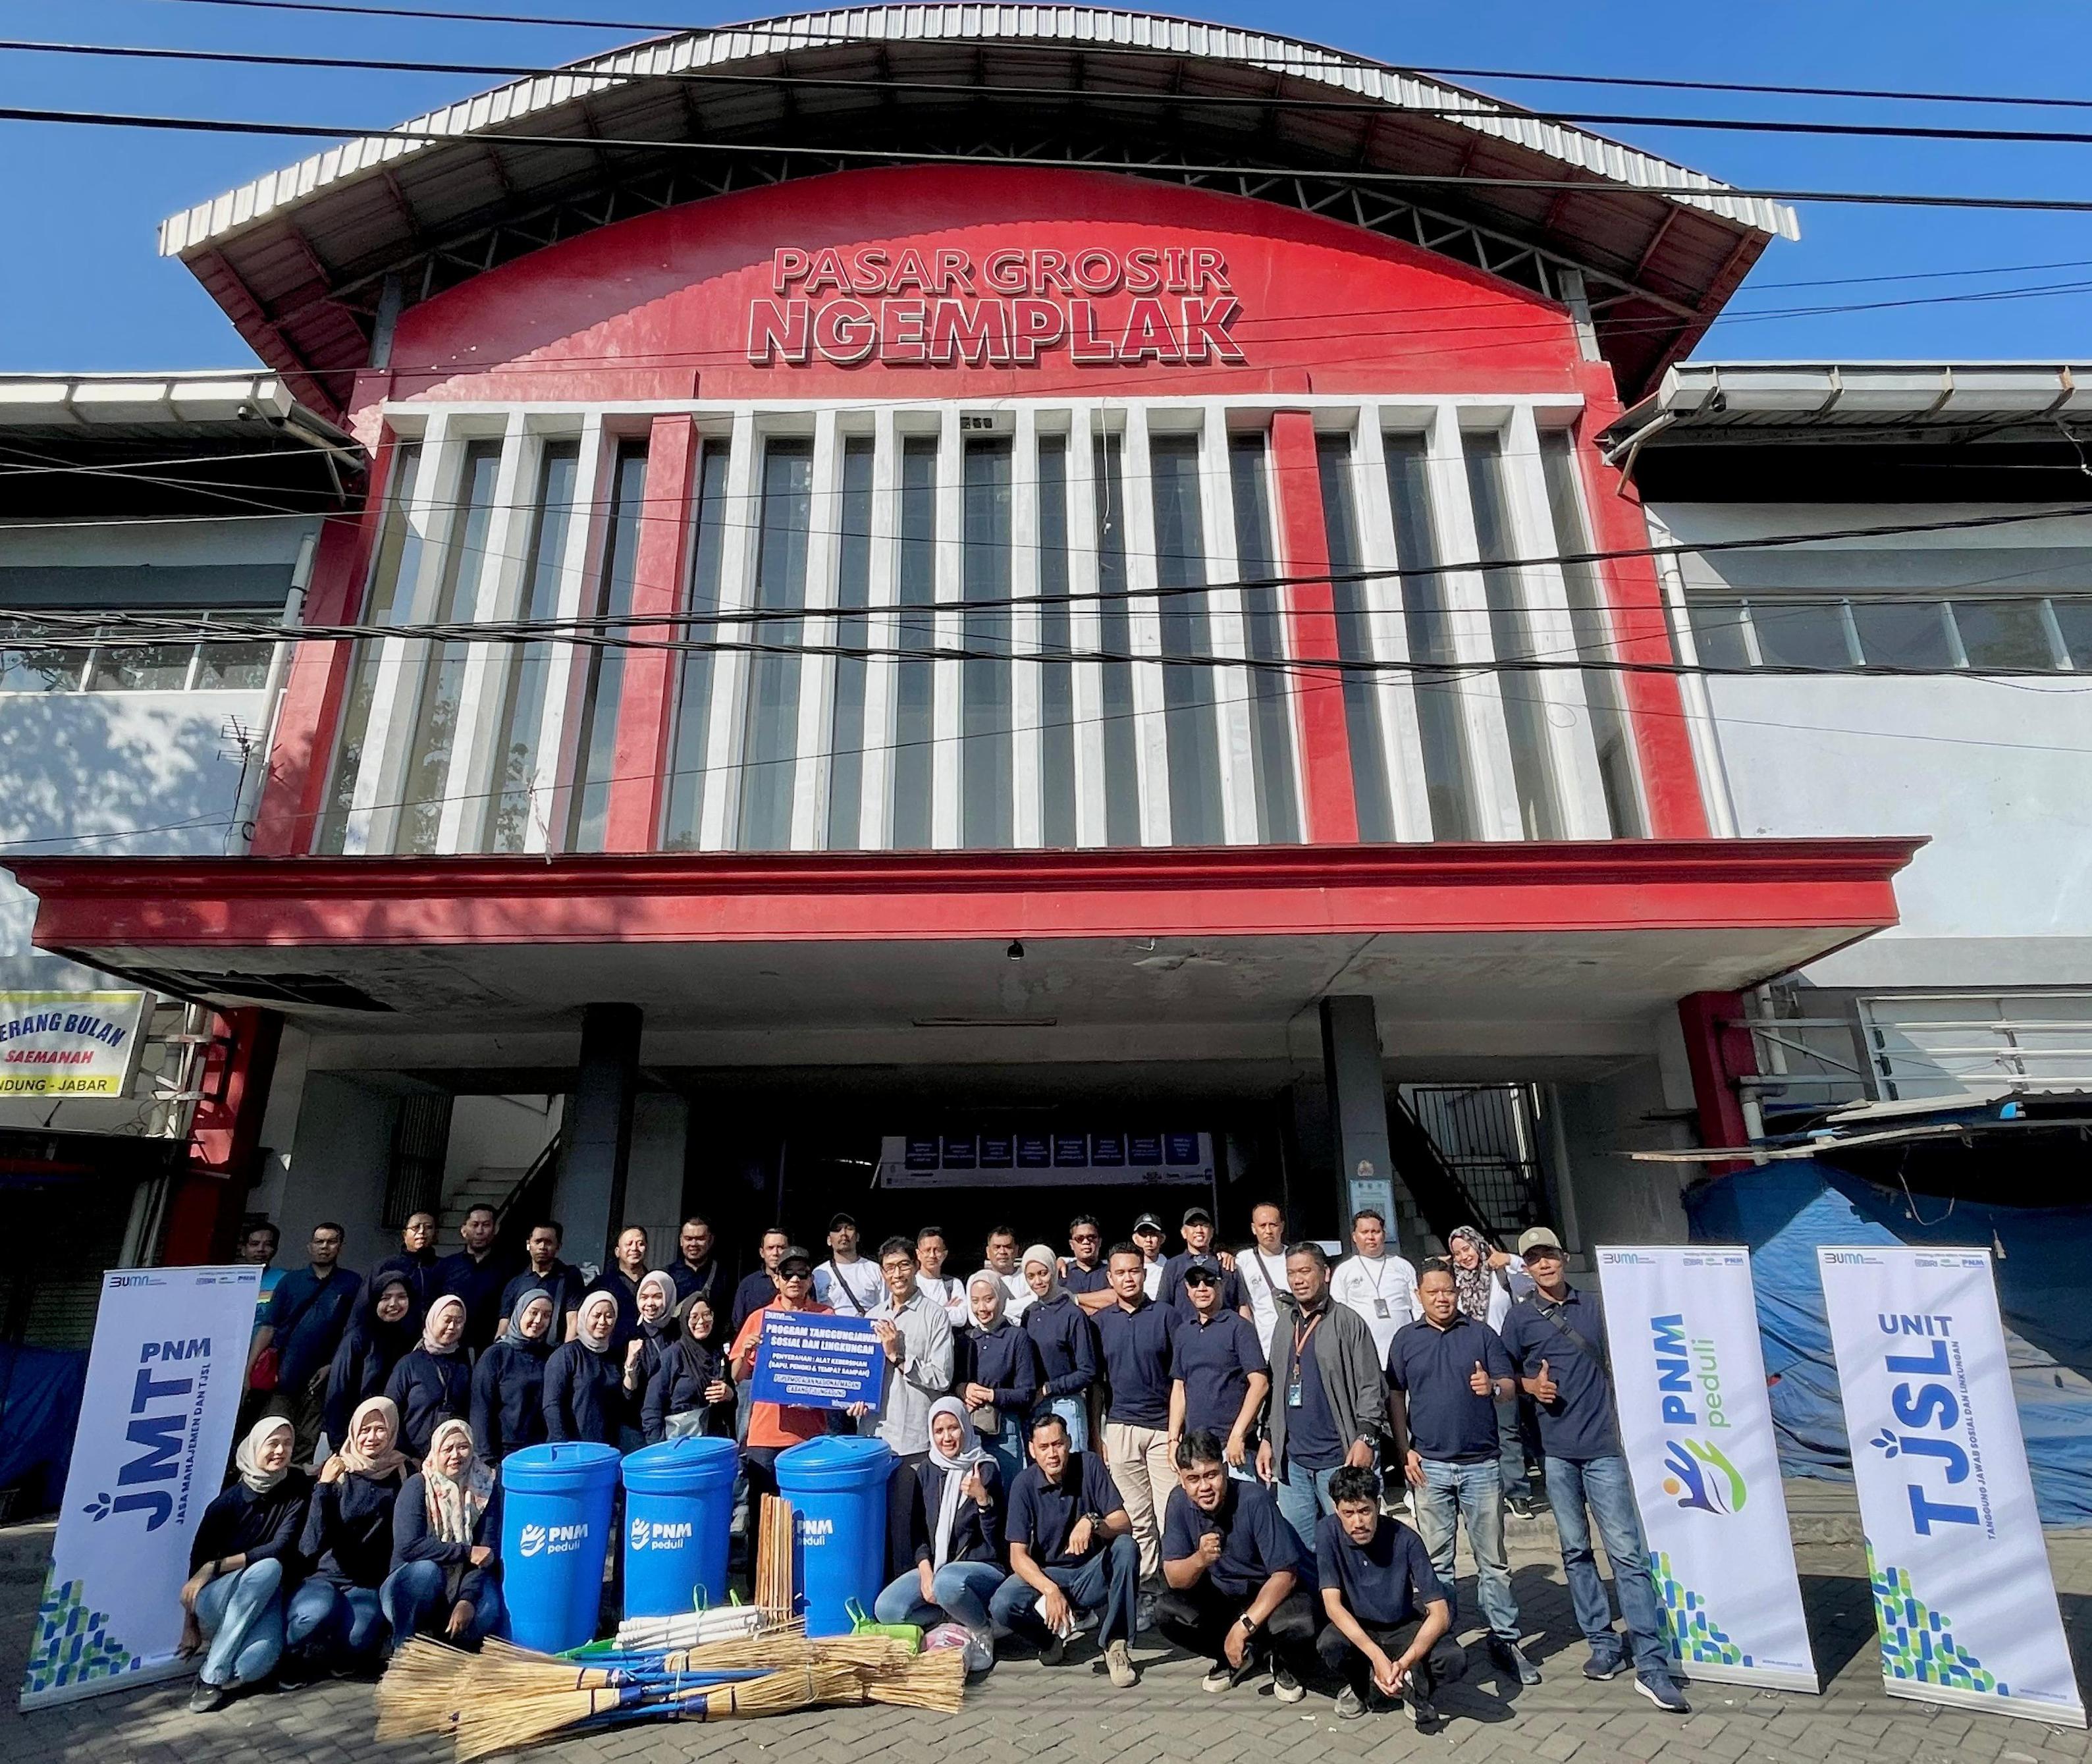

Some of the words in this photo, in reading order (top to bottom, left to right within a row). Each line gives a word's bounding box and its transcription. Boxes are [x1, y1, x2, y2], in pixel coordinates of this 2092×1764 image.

[772, 248, 975, 294] PASAR
[982, 248, 1231, 294] GROSIR
[746, 296, 1248, 365] NGEMPLAK
[64, 1014, 126, 1047] BULAN
[58, 1080, 107, 1091] JABAR
[766, 1323, 809, 1335] PROGRAM
[1878, 1314, 1952, 1337] UNIT
[140, 1338, 211, 1363] PNM
[770, 1336, 801, 1349] SOSIAL
[801, 1339, 820, 1350] DAN
[820, 1341, 874, 1355] LINGKUNGAN
[815, 1356, 831, 1364] ALAT
[817, 1366, 842, 1374] TEMPAT
[1650, 1314, 1697, 1425] PNM
[199, 1362, 211, 1389] TJSL
[1691, 1339, 1731, 1428] peduli
[194, 1391, 205, 1416] DAN
[1962, 1395, 1972, 1416] DAN
[1885, 1339, 1980, 1536] TJSL
[1966, 1416, 1979, 1449] SOSIAL
[113, 1368, 193, 1532] JMT
[182, 1418, 201, 1493] MANAJEMEN
[1972, 1451, 1986, 1485] JAWAB
[175, 1493, 189, 1525] JASA
[1979, 1487, 1996, 1540] TANGGUNG
[548, 1524, 588, 1542] PNM
[652, 1522, 692, 1538] PNM
[797, 1520, 833, 1534] PNM
[547, 1541, 580, 1555] peduli
[652, 1539, 684, 1551] peduli
